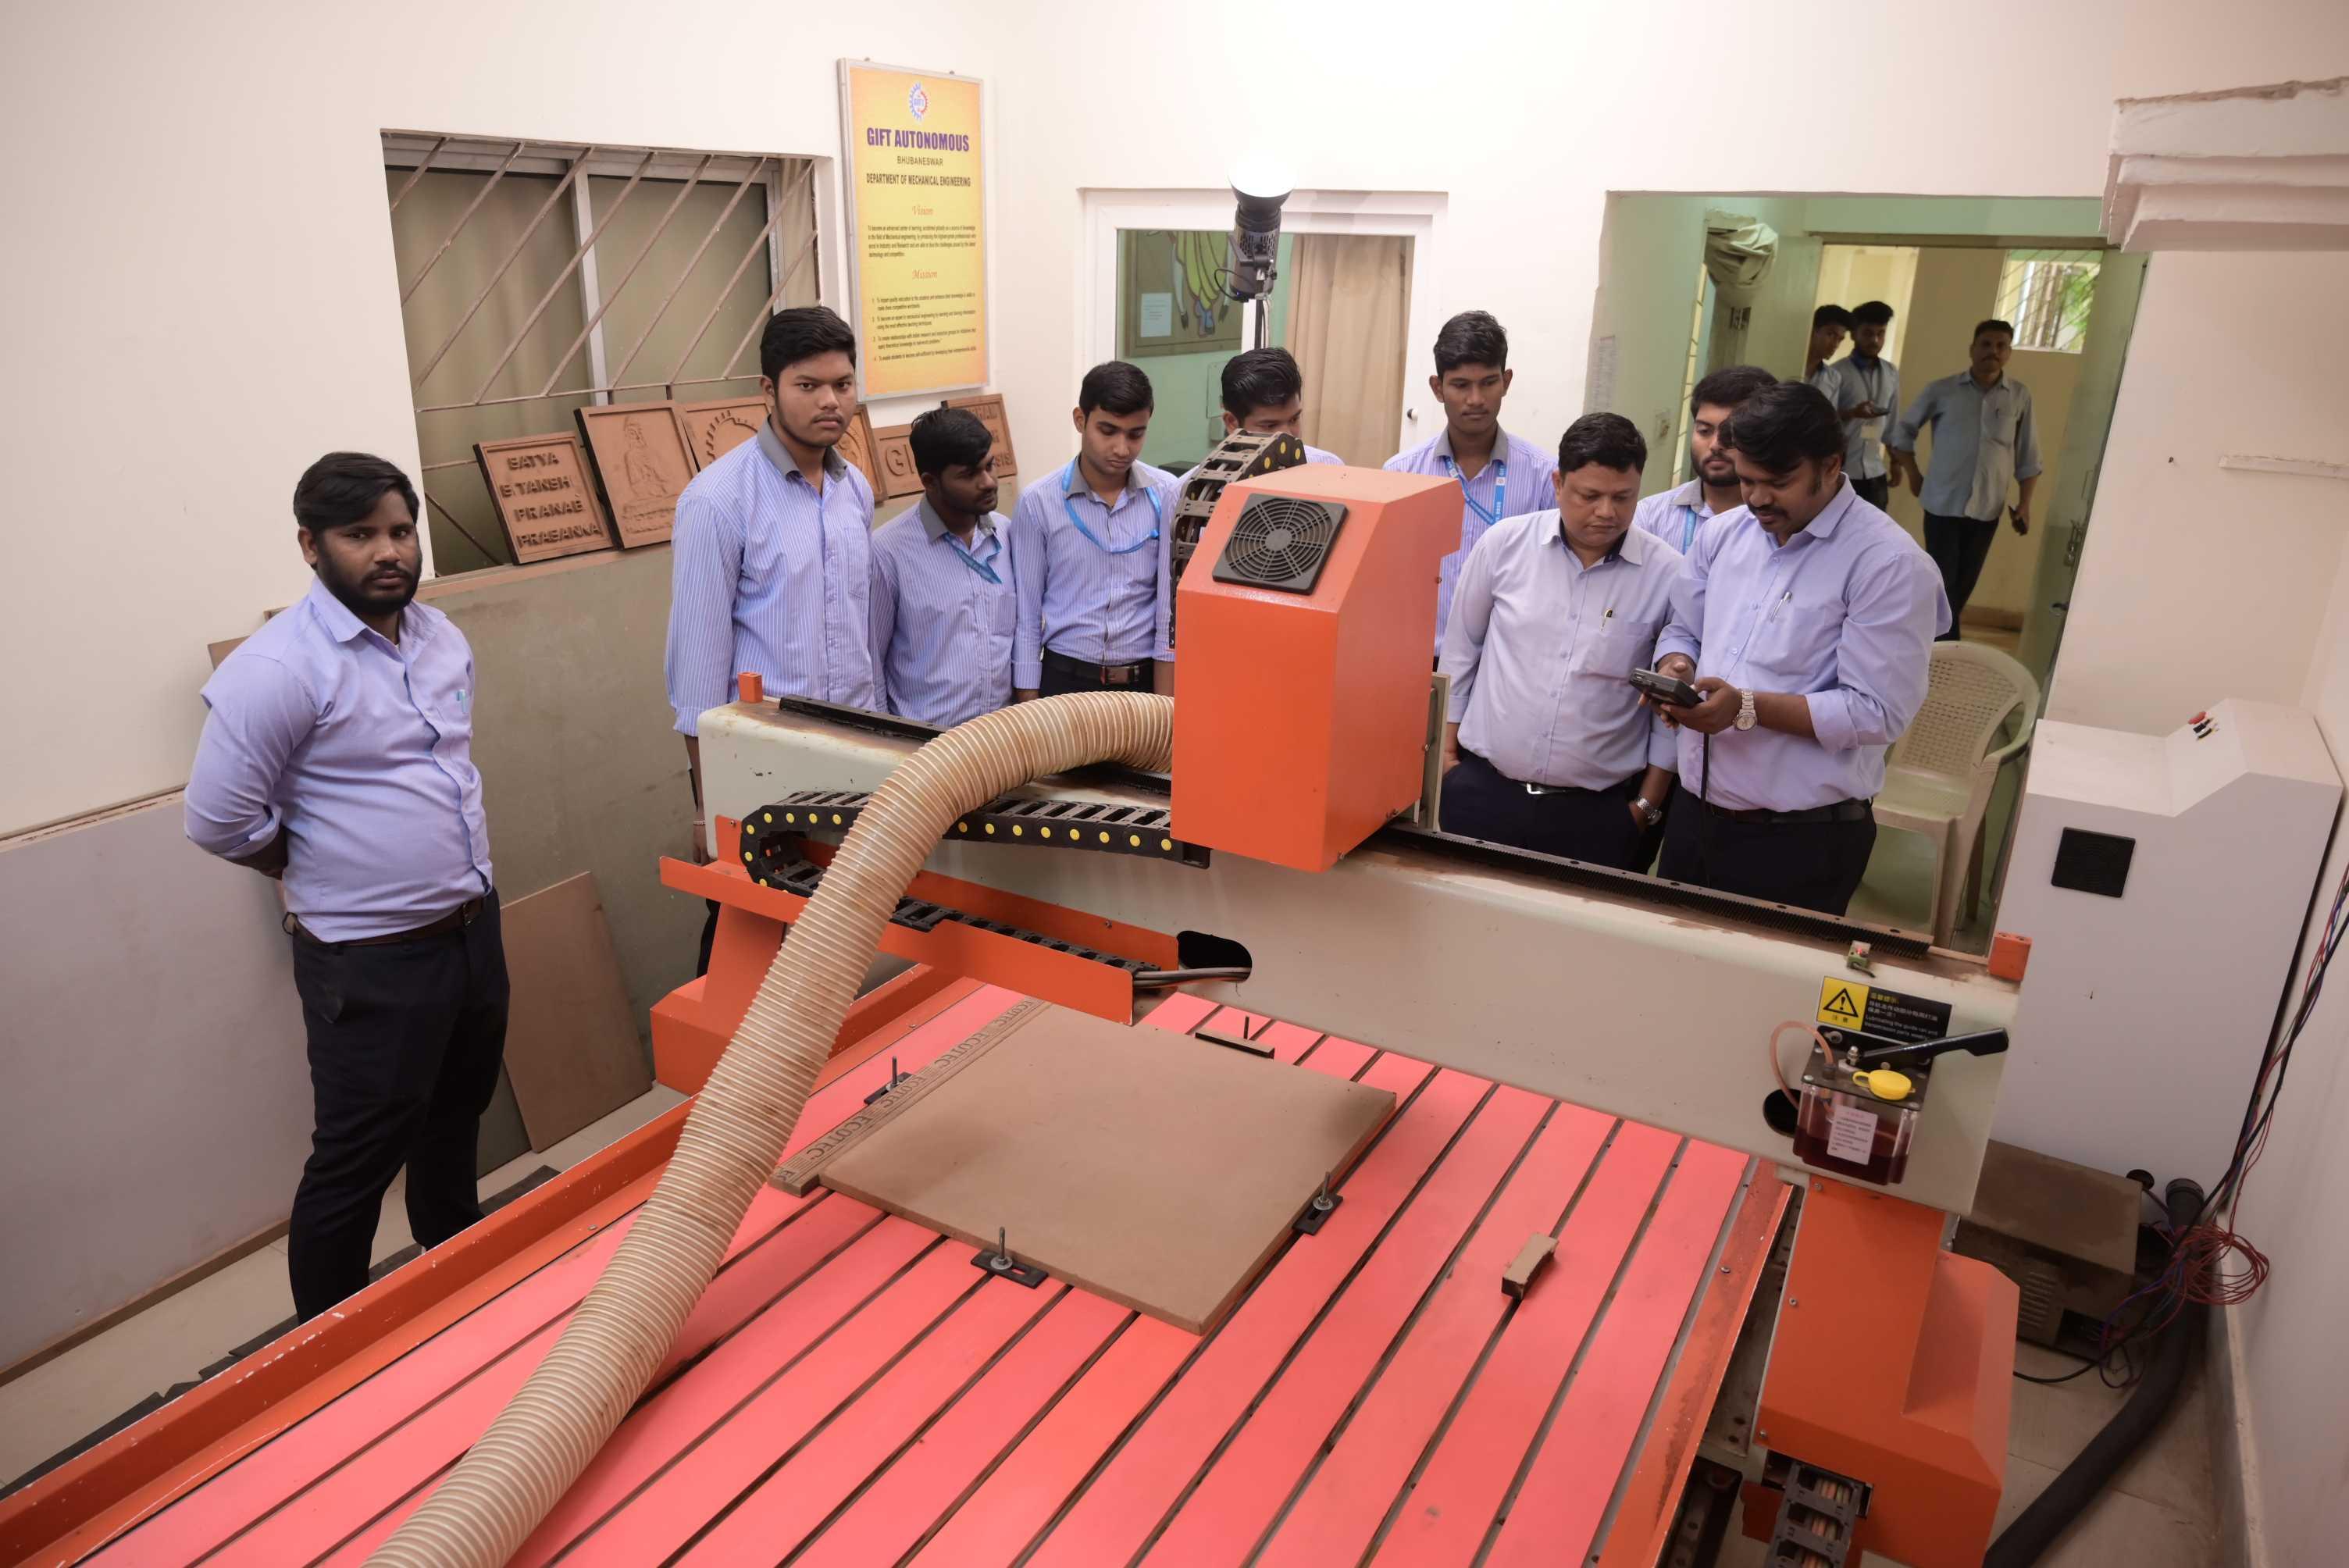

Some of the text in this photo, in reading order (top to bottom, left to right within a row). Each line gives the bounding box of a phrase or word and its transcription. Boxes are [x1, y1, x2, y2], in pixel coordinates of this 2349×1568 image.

[867, 127, 970, 151] GIFT AUTONOMOUS
[896, 155, 943, 166] BHUBANESWAR
[866, 173, 971, 187] DEPARTMENT OF MECHANICAL ENGINEERING
[886, 444, 914, 476] GI
[996, 998, 1035, 1027] ECOTEC
[934, 1030, 989, 1068] ECOTEC
[880, 1075, 926, 1109] ECOTEC
[806, 1114, 873, 1161] ECOTEC
